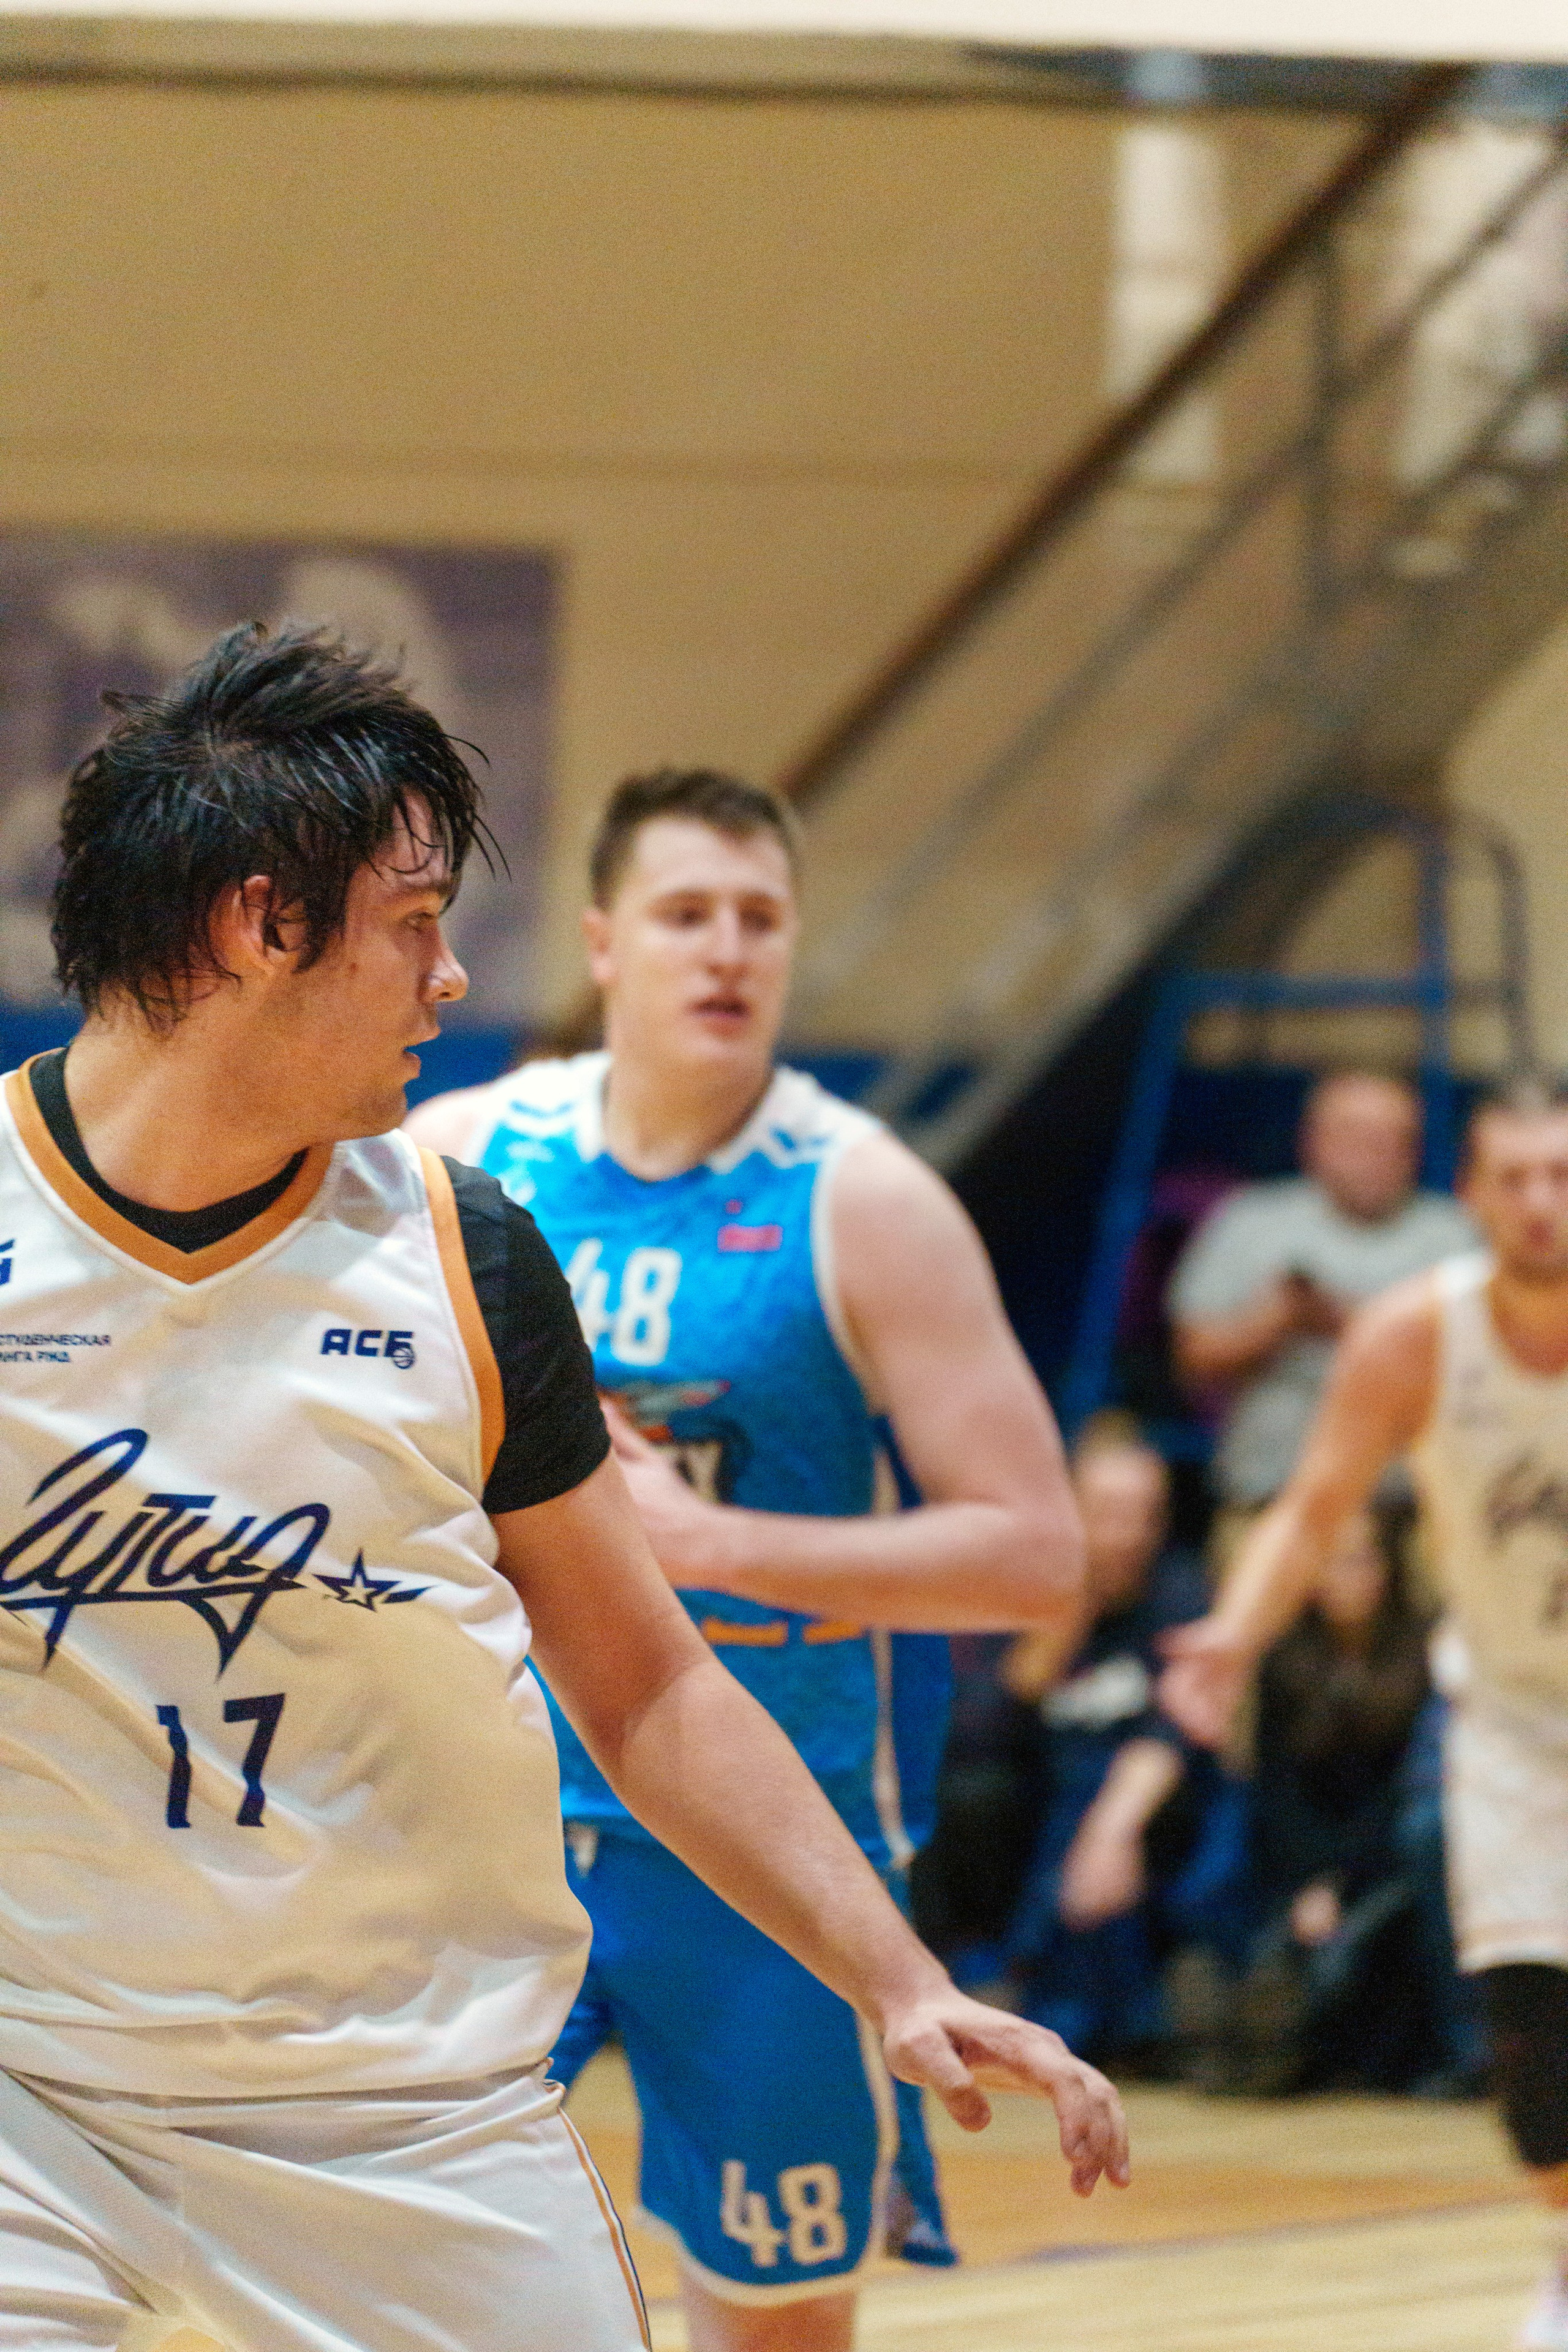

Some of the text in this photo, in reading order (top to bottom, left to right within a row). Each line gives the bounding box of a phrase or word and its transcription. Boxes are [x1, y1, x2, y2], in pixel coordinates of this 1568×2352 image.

[566, 1237, 684, 1367] 48
[156, 1692, 285, 1829] 17
[720, 2158, 848, 2267] 48
